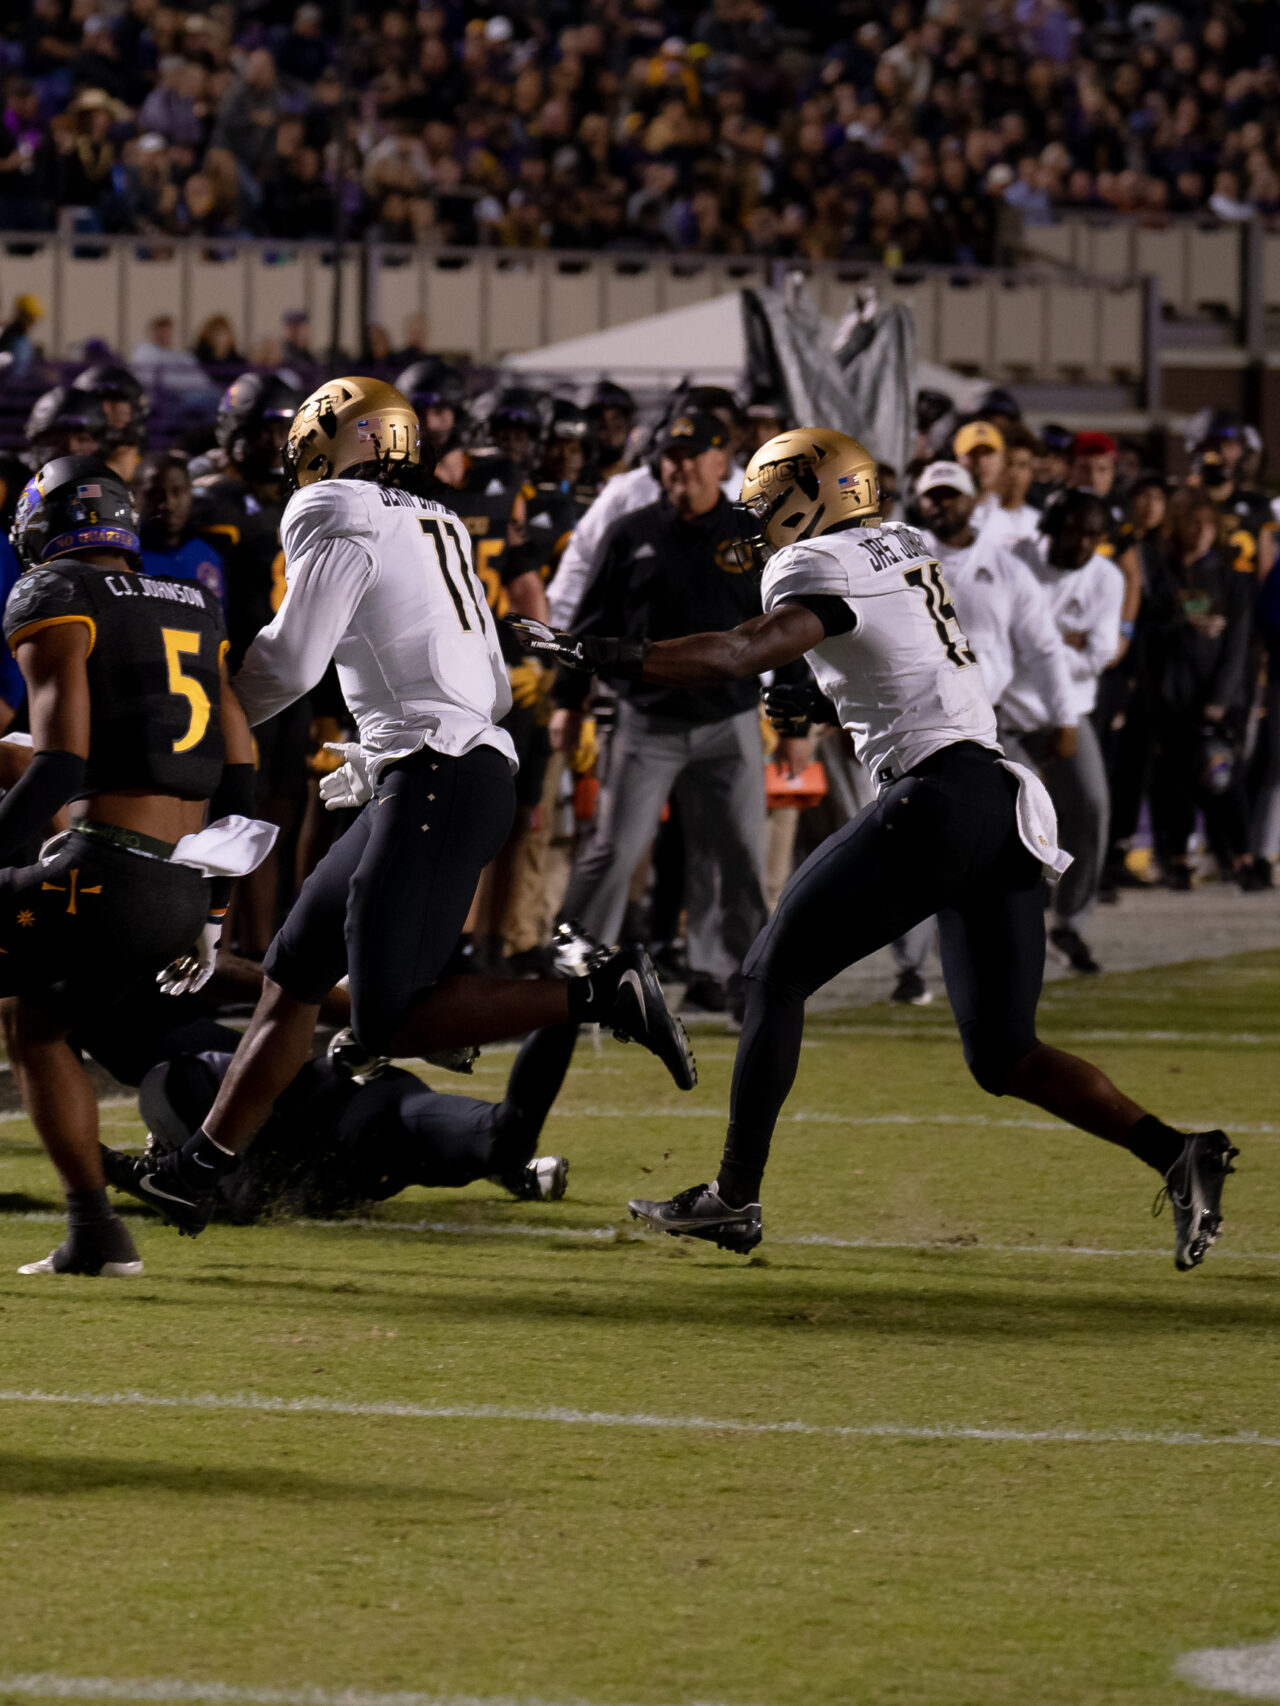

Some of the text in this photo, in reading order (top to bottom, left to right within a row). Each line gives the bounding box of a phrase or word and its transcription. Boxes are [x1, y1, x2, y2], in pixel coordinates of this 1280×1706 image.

[757, 455, 818, 488] UCF
[88, 510, 99, 525] 5
[56, 530, 134, 548] NO QUARTER
[105, 575, 206, 609] C.J. JOHNSON
[416, 516, 486, 637] 11
[160, 627, 211, 754] 5
